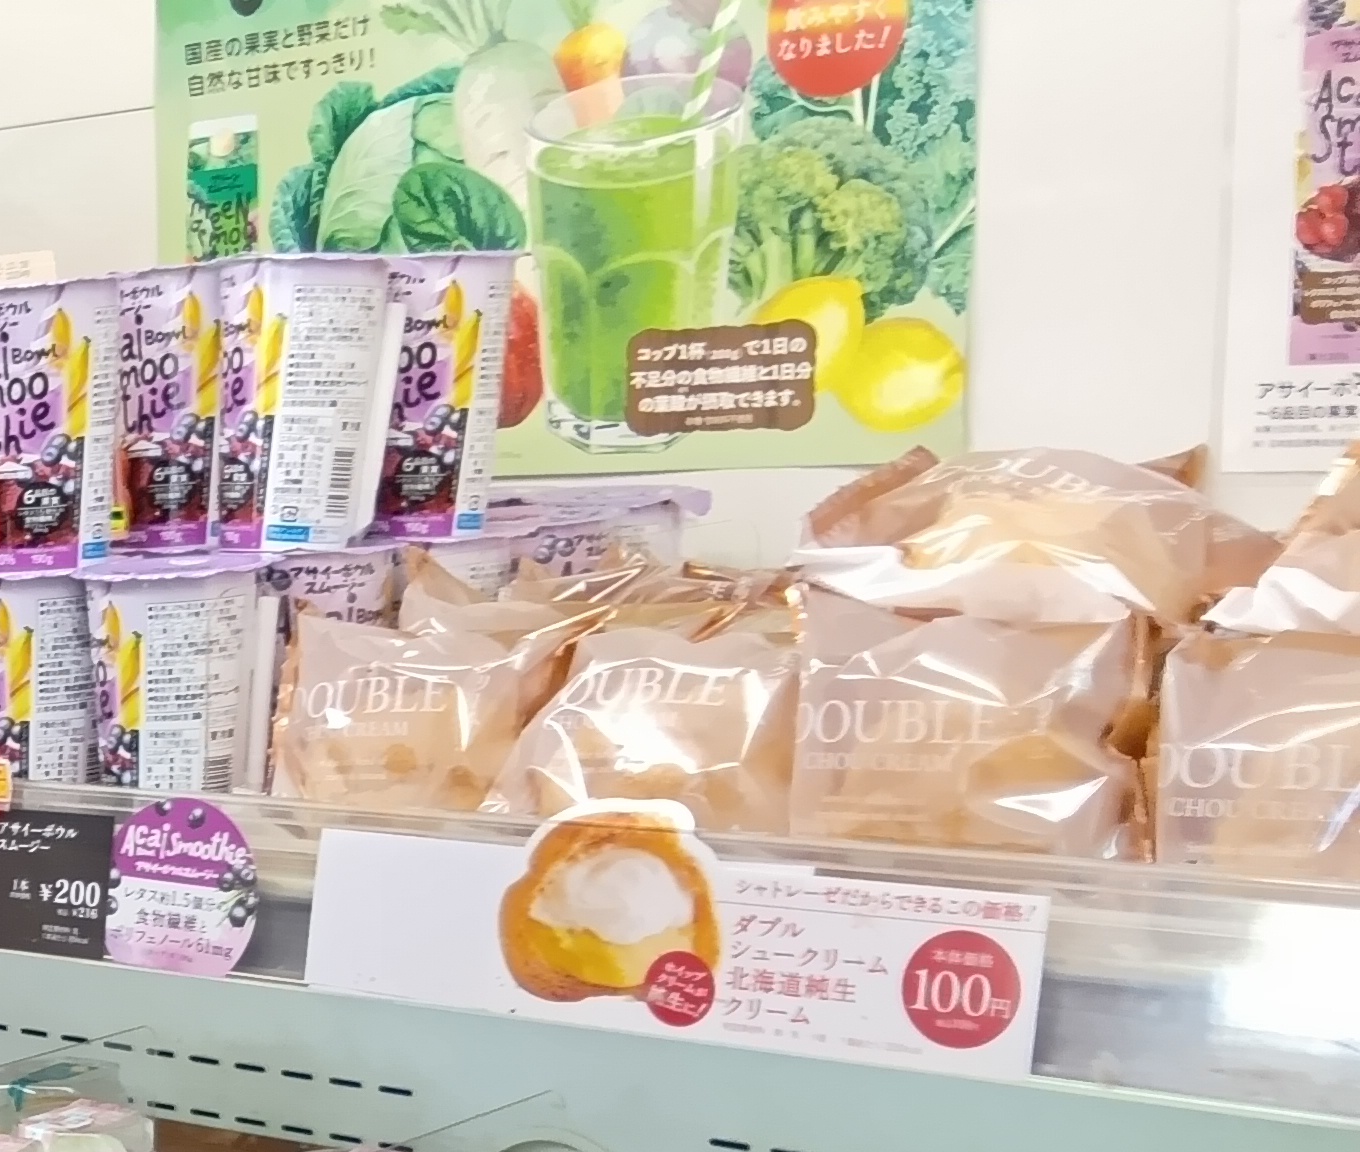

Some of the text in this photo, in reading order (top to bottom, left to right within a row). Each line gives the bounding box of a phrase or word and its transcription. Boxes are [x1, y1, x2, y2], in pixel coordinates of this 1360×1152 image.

[185, 16, 370, 66] 国産の果実と野菜だけ
[777, 25, 892, 61] なりました!
[188, 48, 376, 97] 自然な甘味ですっきり!
[119, 822, 249, 866] Acai Smoothie
[38, 878, 101, 907] ¥200
[735, 879, 1038, 922] シャトレーゼだからできるこの価格!
[109, 926, 234, 961] ポリフェノール61mg
[731, 913, 806, 938] ダブル
[730, 940, 889, 976] シュークリーム
[726, 965, 857, 1004] 北海道純生
[908, 967, 1012, 1020] 100円
[721, 997, 811, 1026] クリーム
